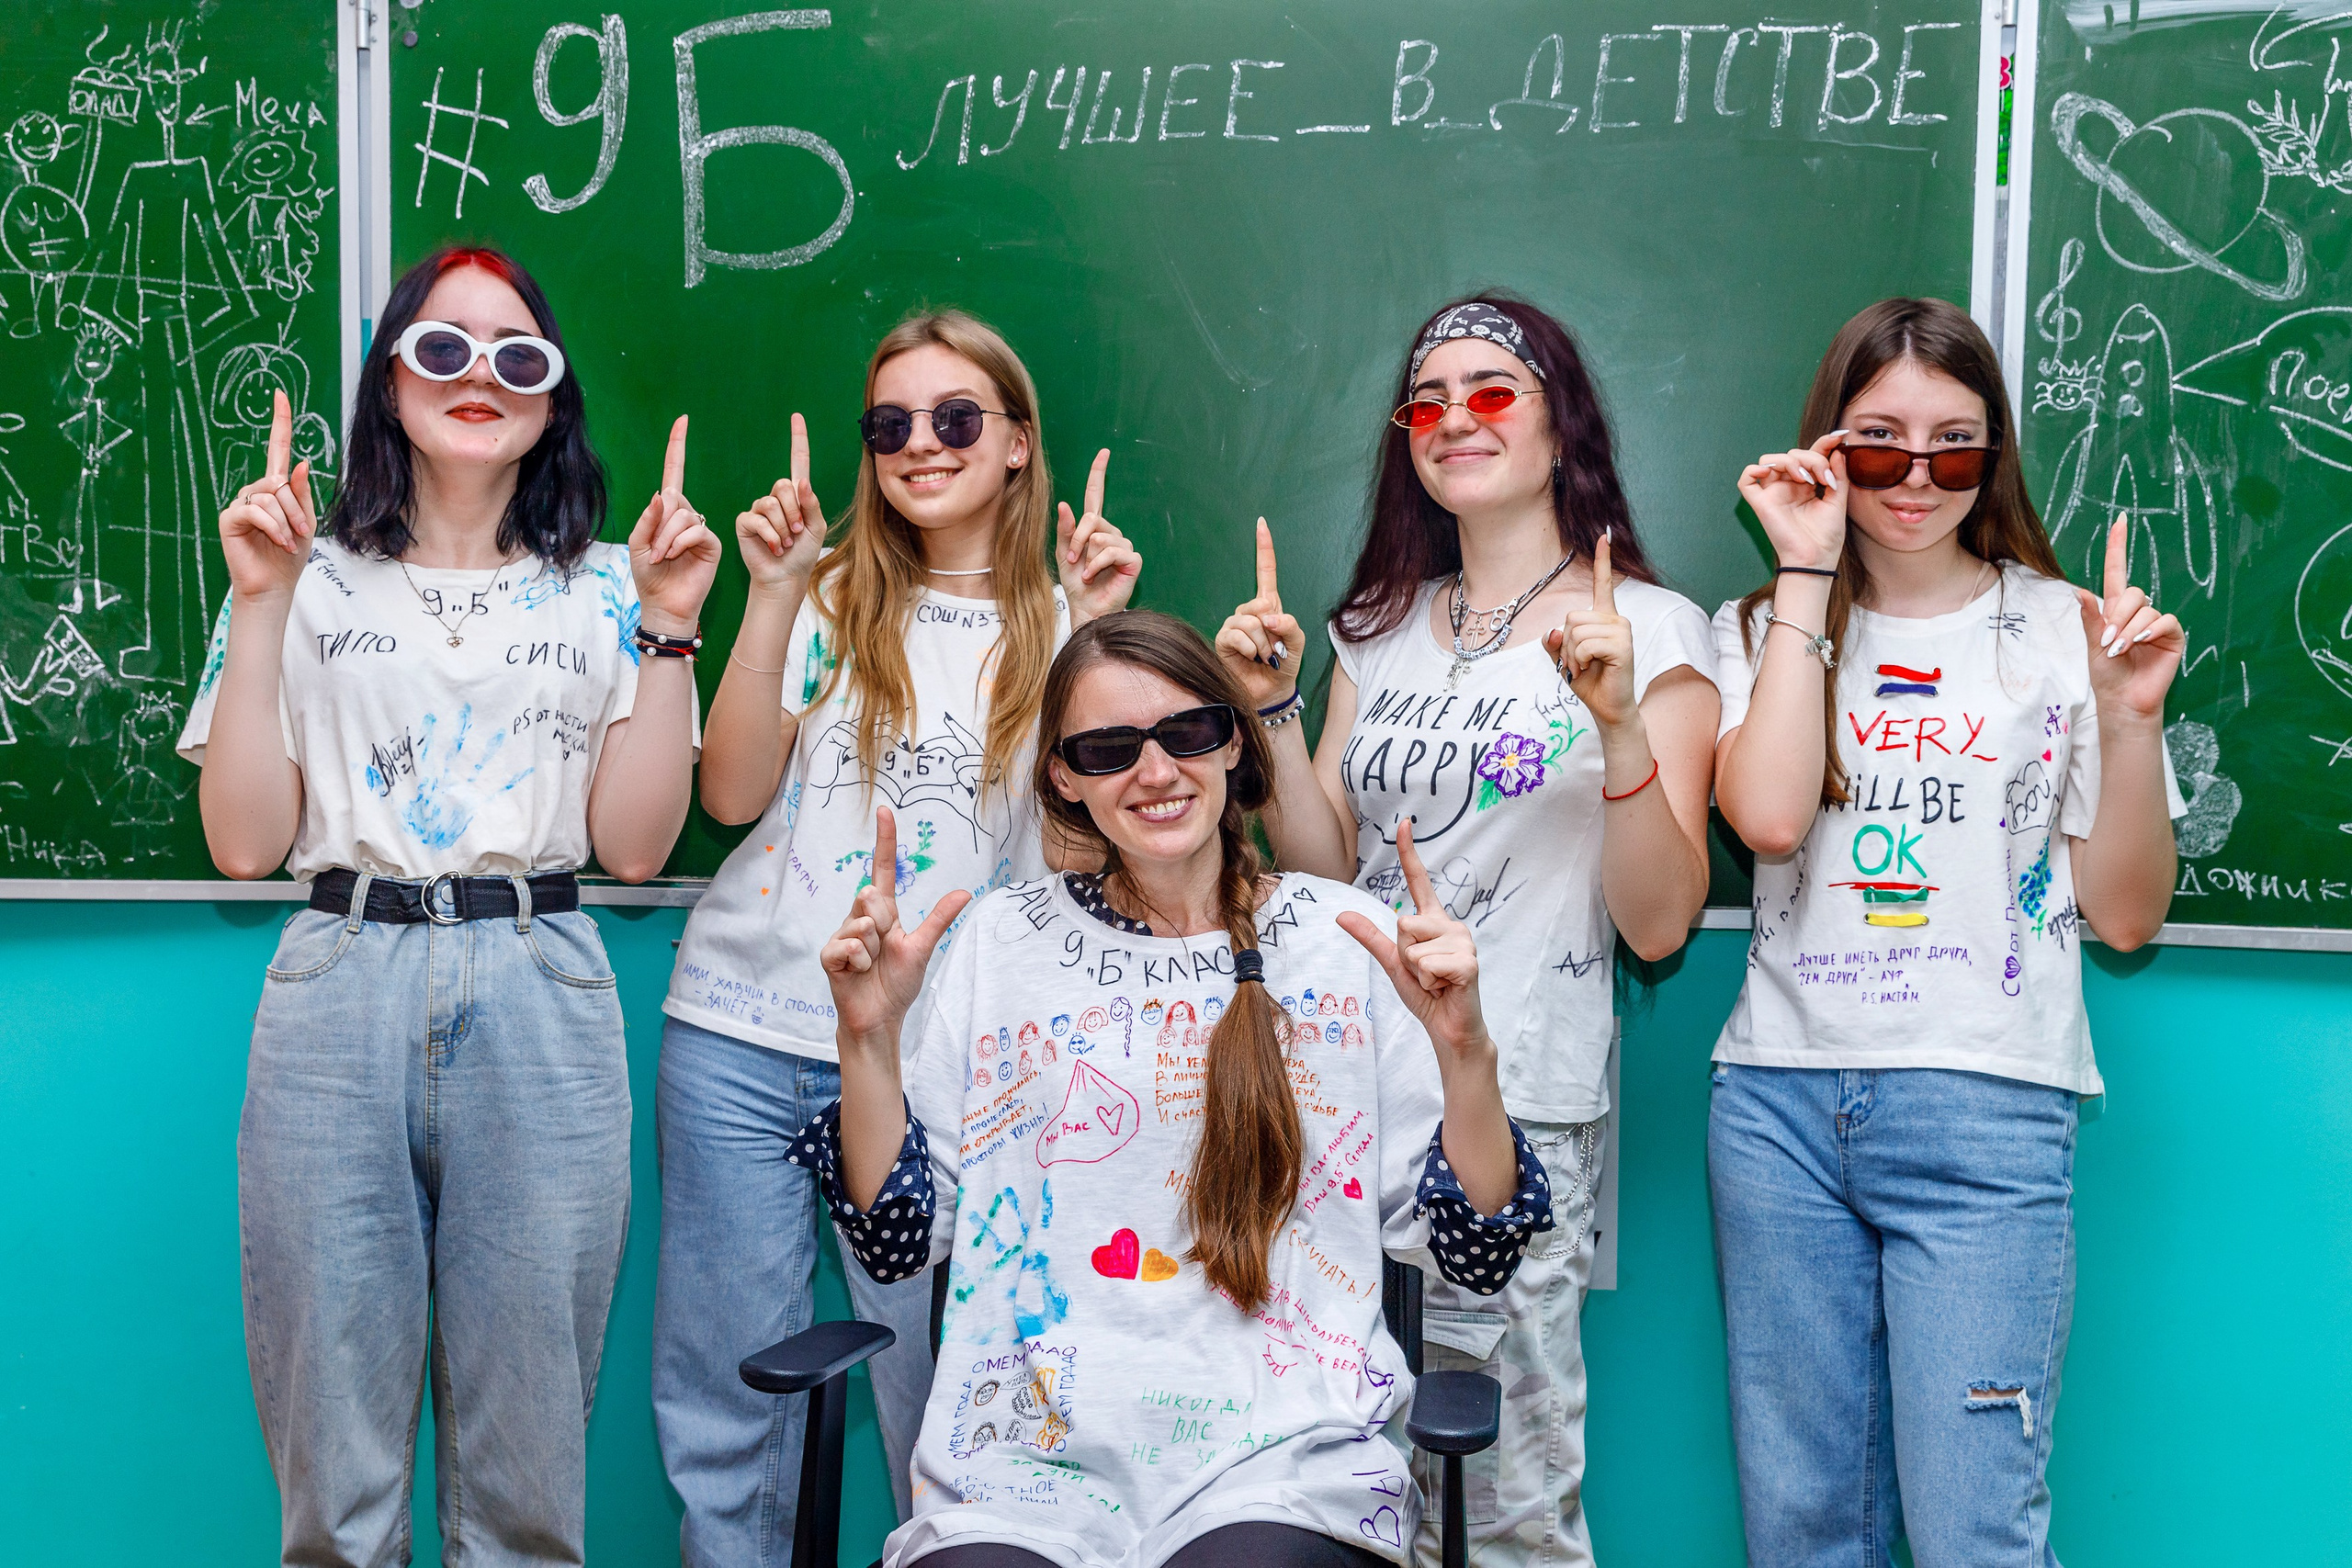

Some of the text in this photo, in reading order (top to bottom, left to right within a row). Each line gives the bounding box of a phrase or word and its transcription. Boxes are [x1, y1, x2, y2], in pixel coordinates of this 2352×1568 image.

[317, 629, 397, 665] ТИПО
[537, 709, 550, 723] ОТ
[1363, 689, 1458, 729] MAKE
[1463, 697, 1518, 731] ME
[1849, 710, 1985, 763] VERY
[1341, 735, 1490, 799] HAPPY
[1919, 776, 1965, 824] BE
[1852, 823, 1928, 879] OK
[1845, 950, 1880, 964] ИМЕТЬ
[1887, 947, 1920, 963] ДРУГ
[705, 990, 750, 1015] ЗАЧЁТ
[1171, 1416, 1213, 1444] ВАС
[1131, 1441, 1162, 1465] НЕ
